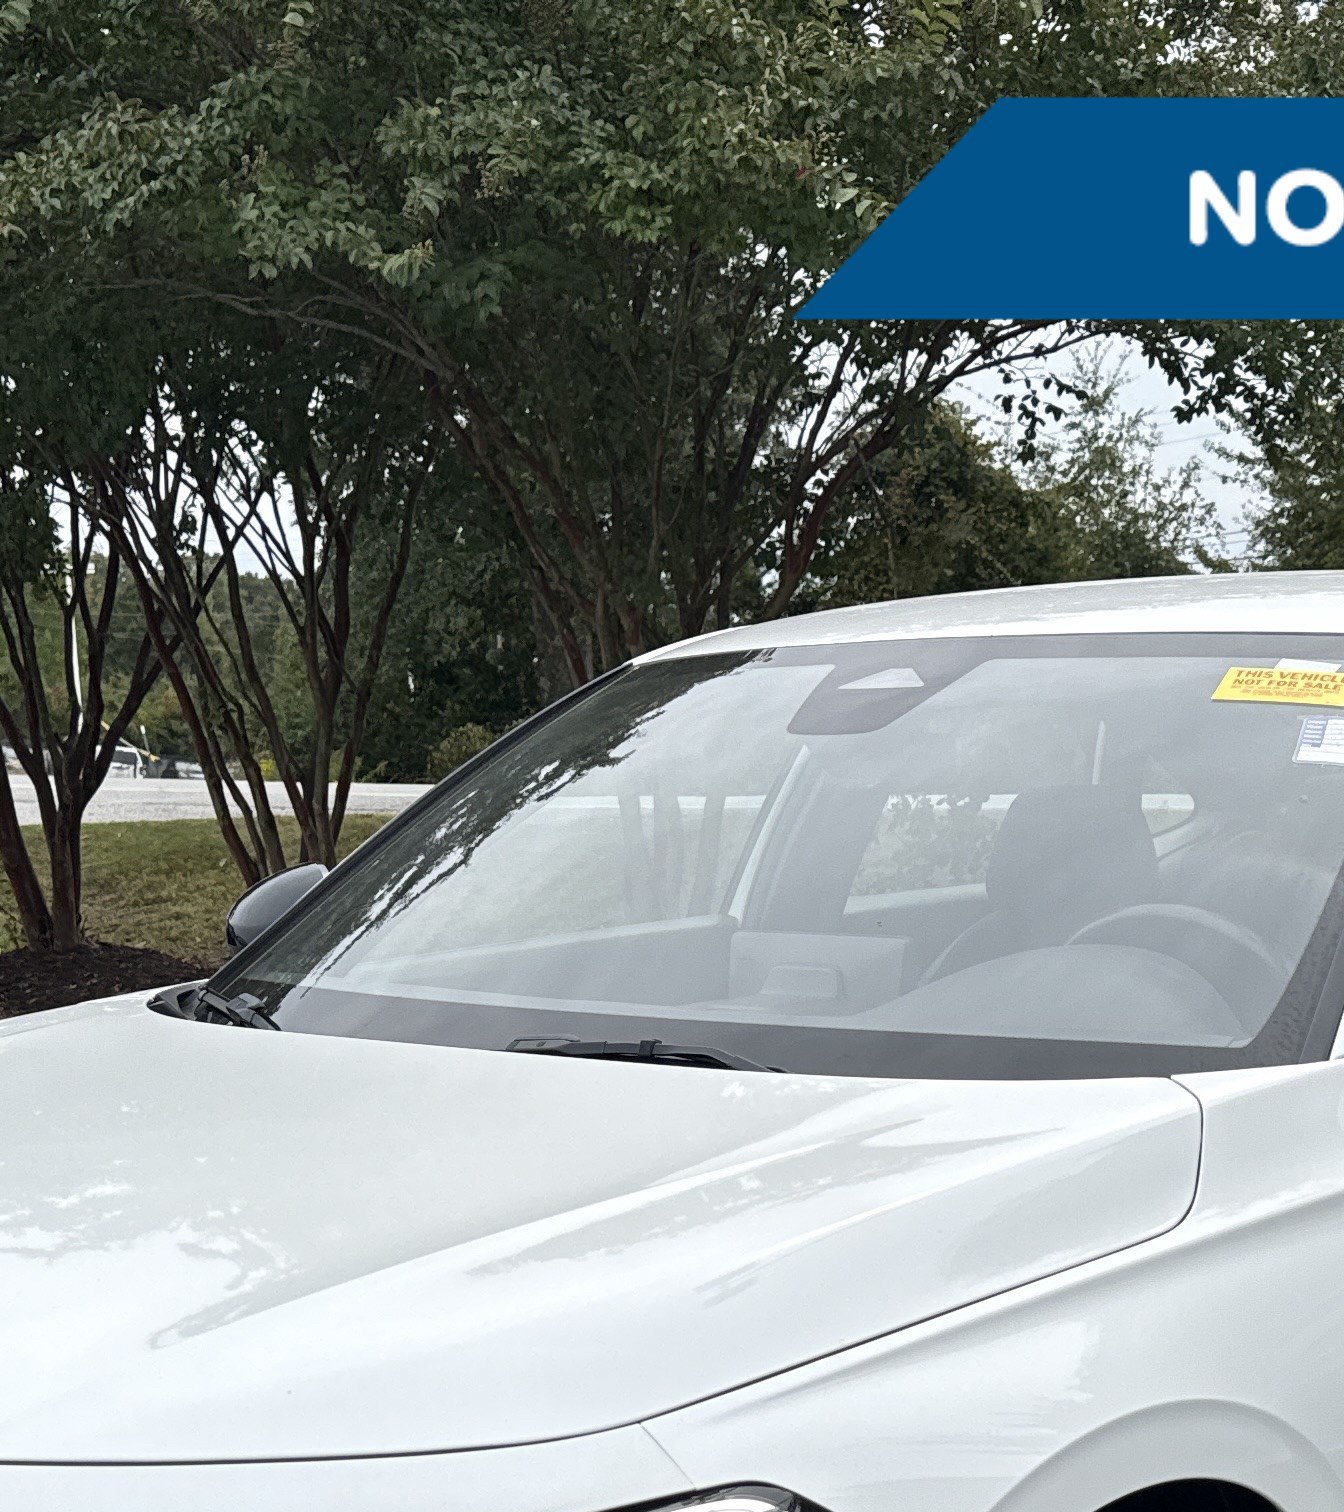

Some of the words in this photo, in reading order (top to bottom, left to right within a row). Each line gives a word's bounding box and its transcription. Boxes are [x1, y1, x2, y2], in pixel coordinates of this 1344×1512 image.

[1235, 669, 1274, 679] THIS
[1232, 678, 1261, 686] NOT
[1267, 679, 1299, 688] FOR
[1302, 681, 1343, 691] SALE
